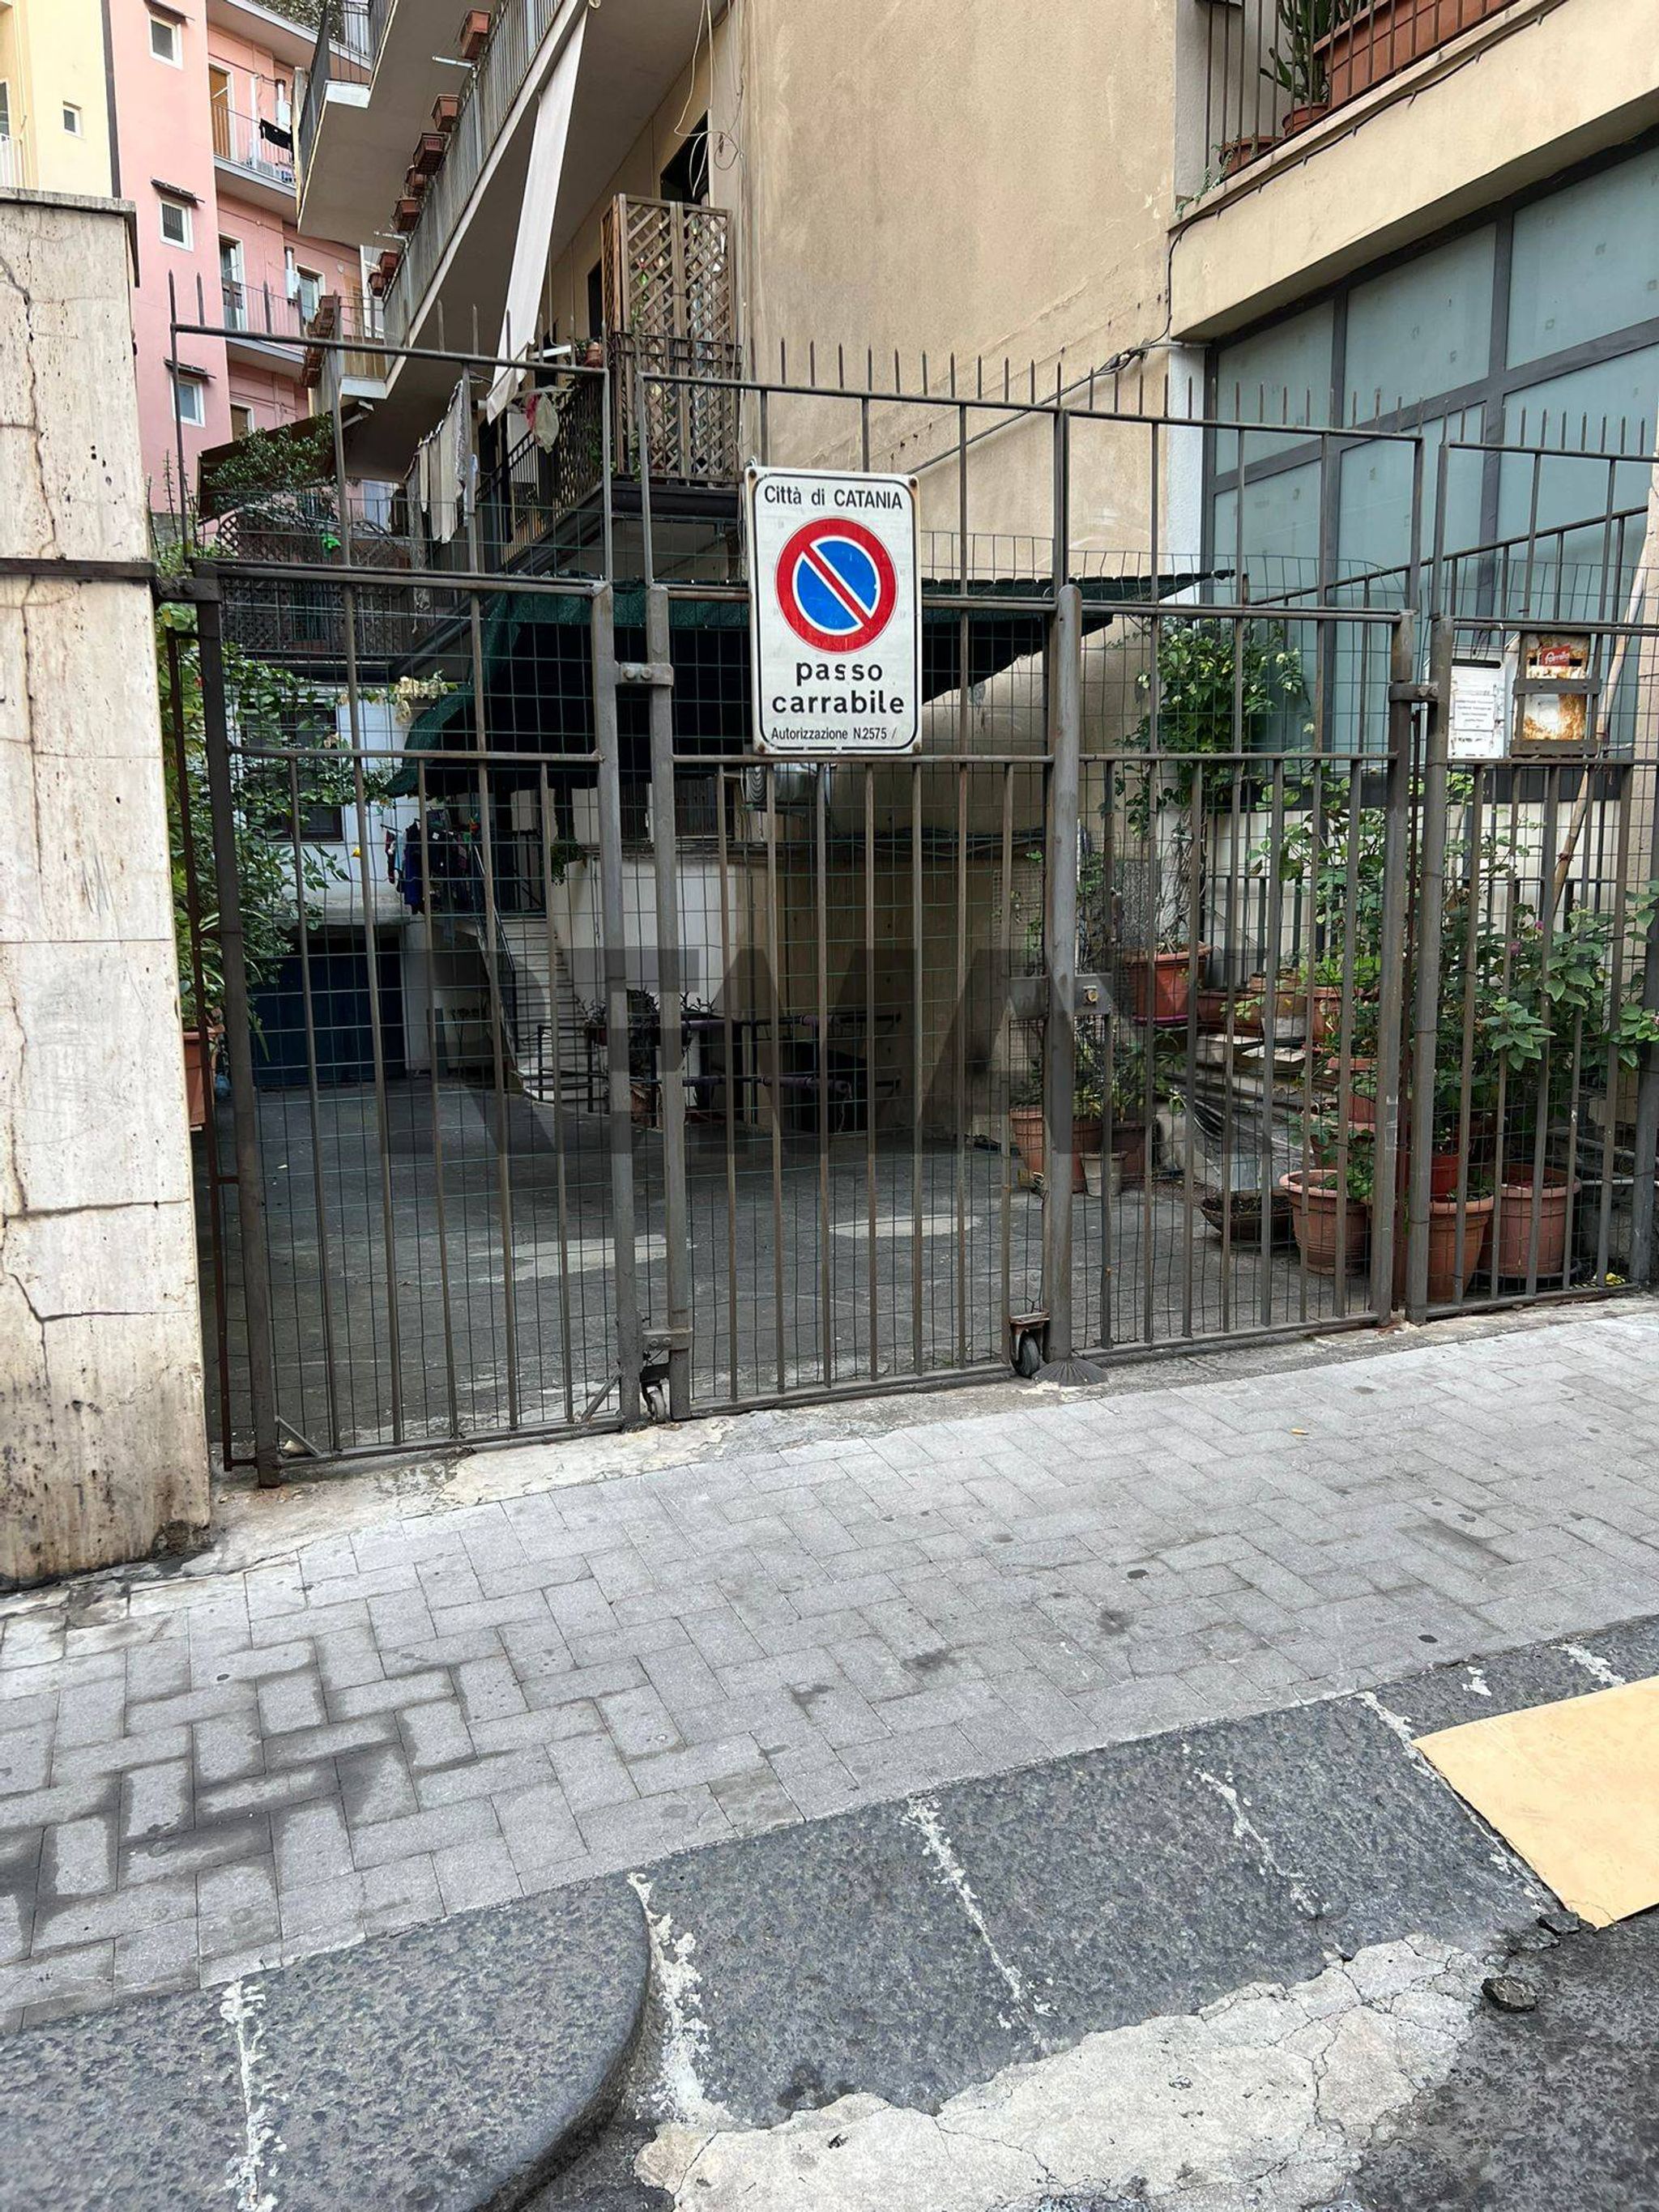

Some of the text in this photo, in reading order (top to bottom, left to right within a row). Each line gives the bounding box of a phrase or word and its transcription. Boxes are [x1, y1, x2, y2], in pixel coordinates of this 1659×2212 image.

[764, 485, 903, 509] Città di CATANIA
[795, 662, 883, 687] passo
[772, 690, 905, 714] carrabile
[771, 727, 848, 740] Autorizzazione
